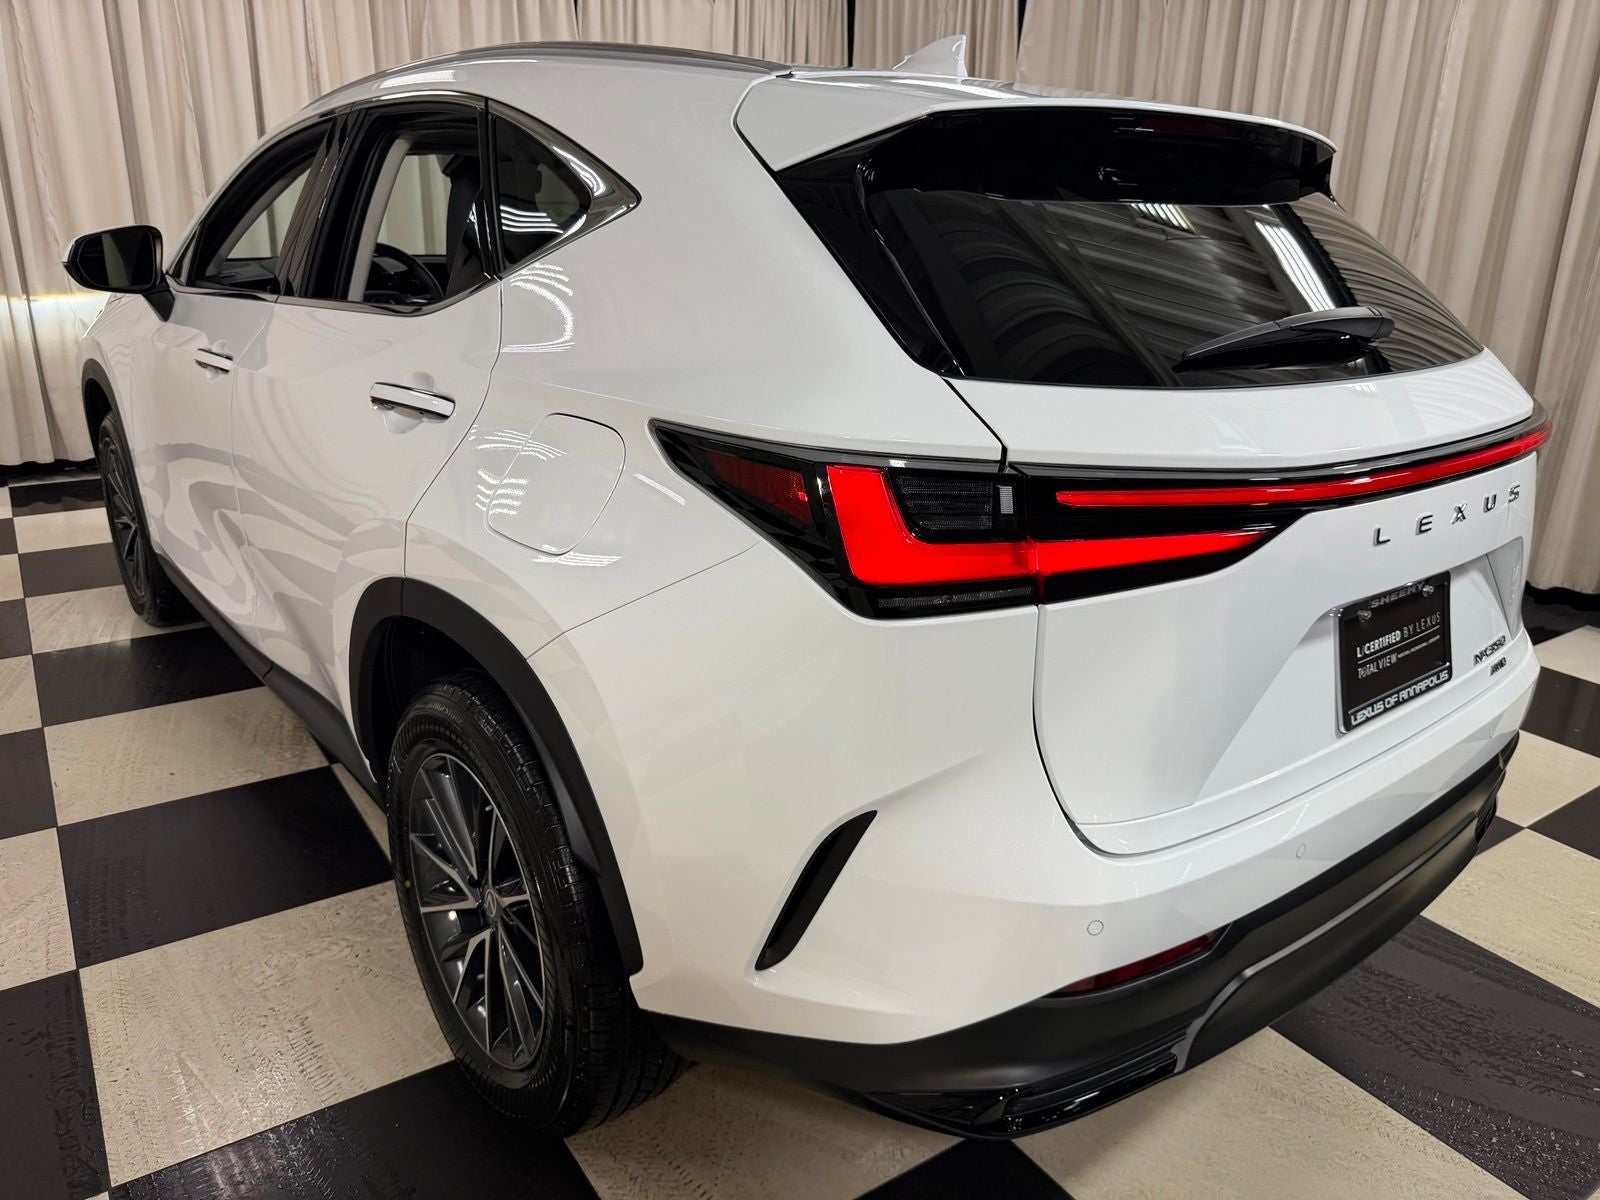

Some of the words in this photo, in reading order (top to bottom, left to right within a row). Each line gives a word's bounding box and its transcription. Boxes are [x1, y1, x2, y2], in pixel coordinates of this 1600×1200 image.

[1373, 483, 1520, 546] LEXUS
[1370, 581, 1424, 608] SHEEHY
[1403, 626, 1414, 638] BY
[1415, 611, 1440, 632] LEXUS
[1378, 652, 1398, 670] VIEW
[1351, 700, 1384, 726] LEXUS
[1385, 694, 1399, 709] OF
[1400, 669, 1449, 702] ANNAPOLIS
